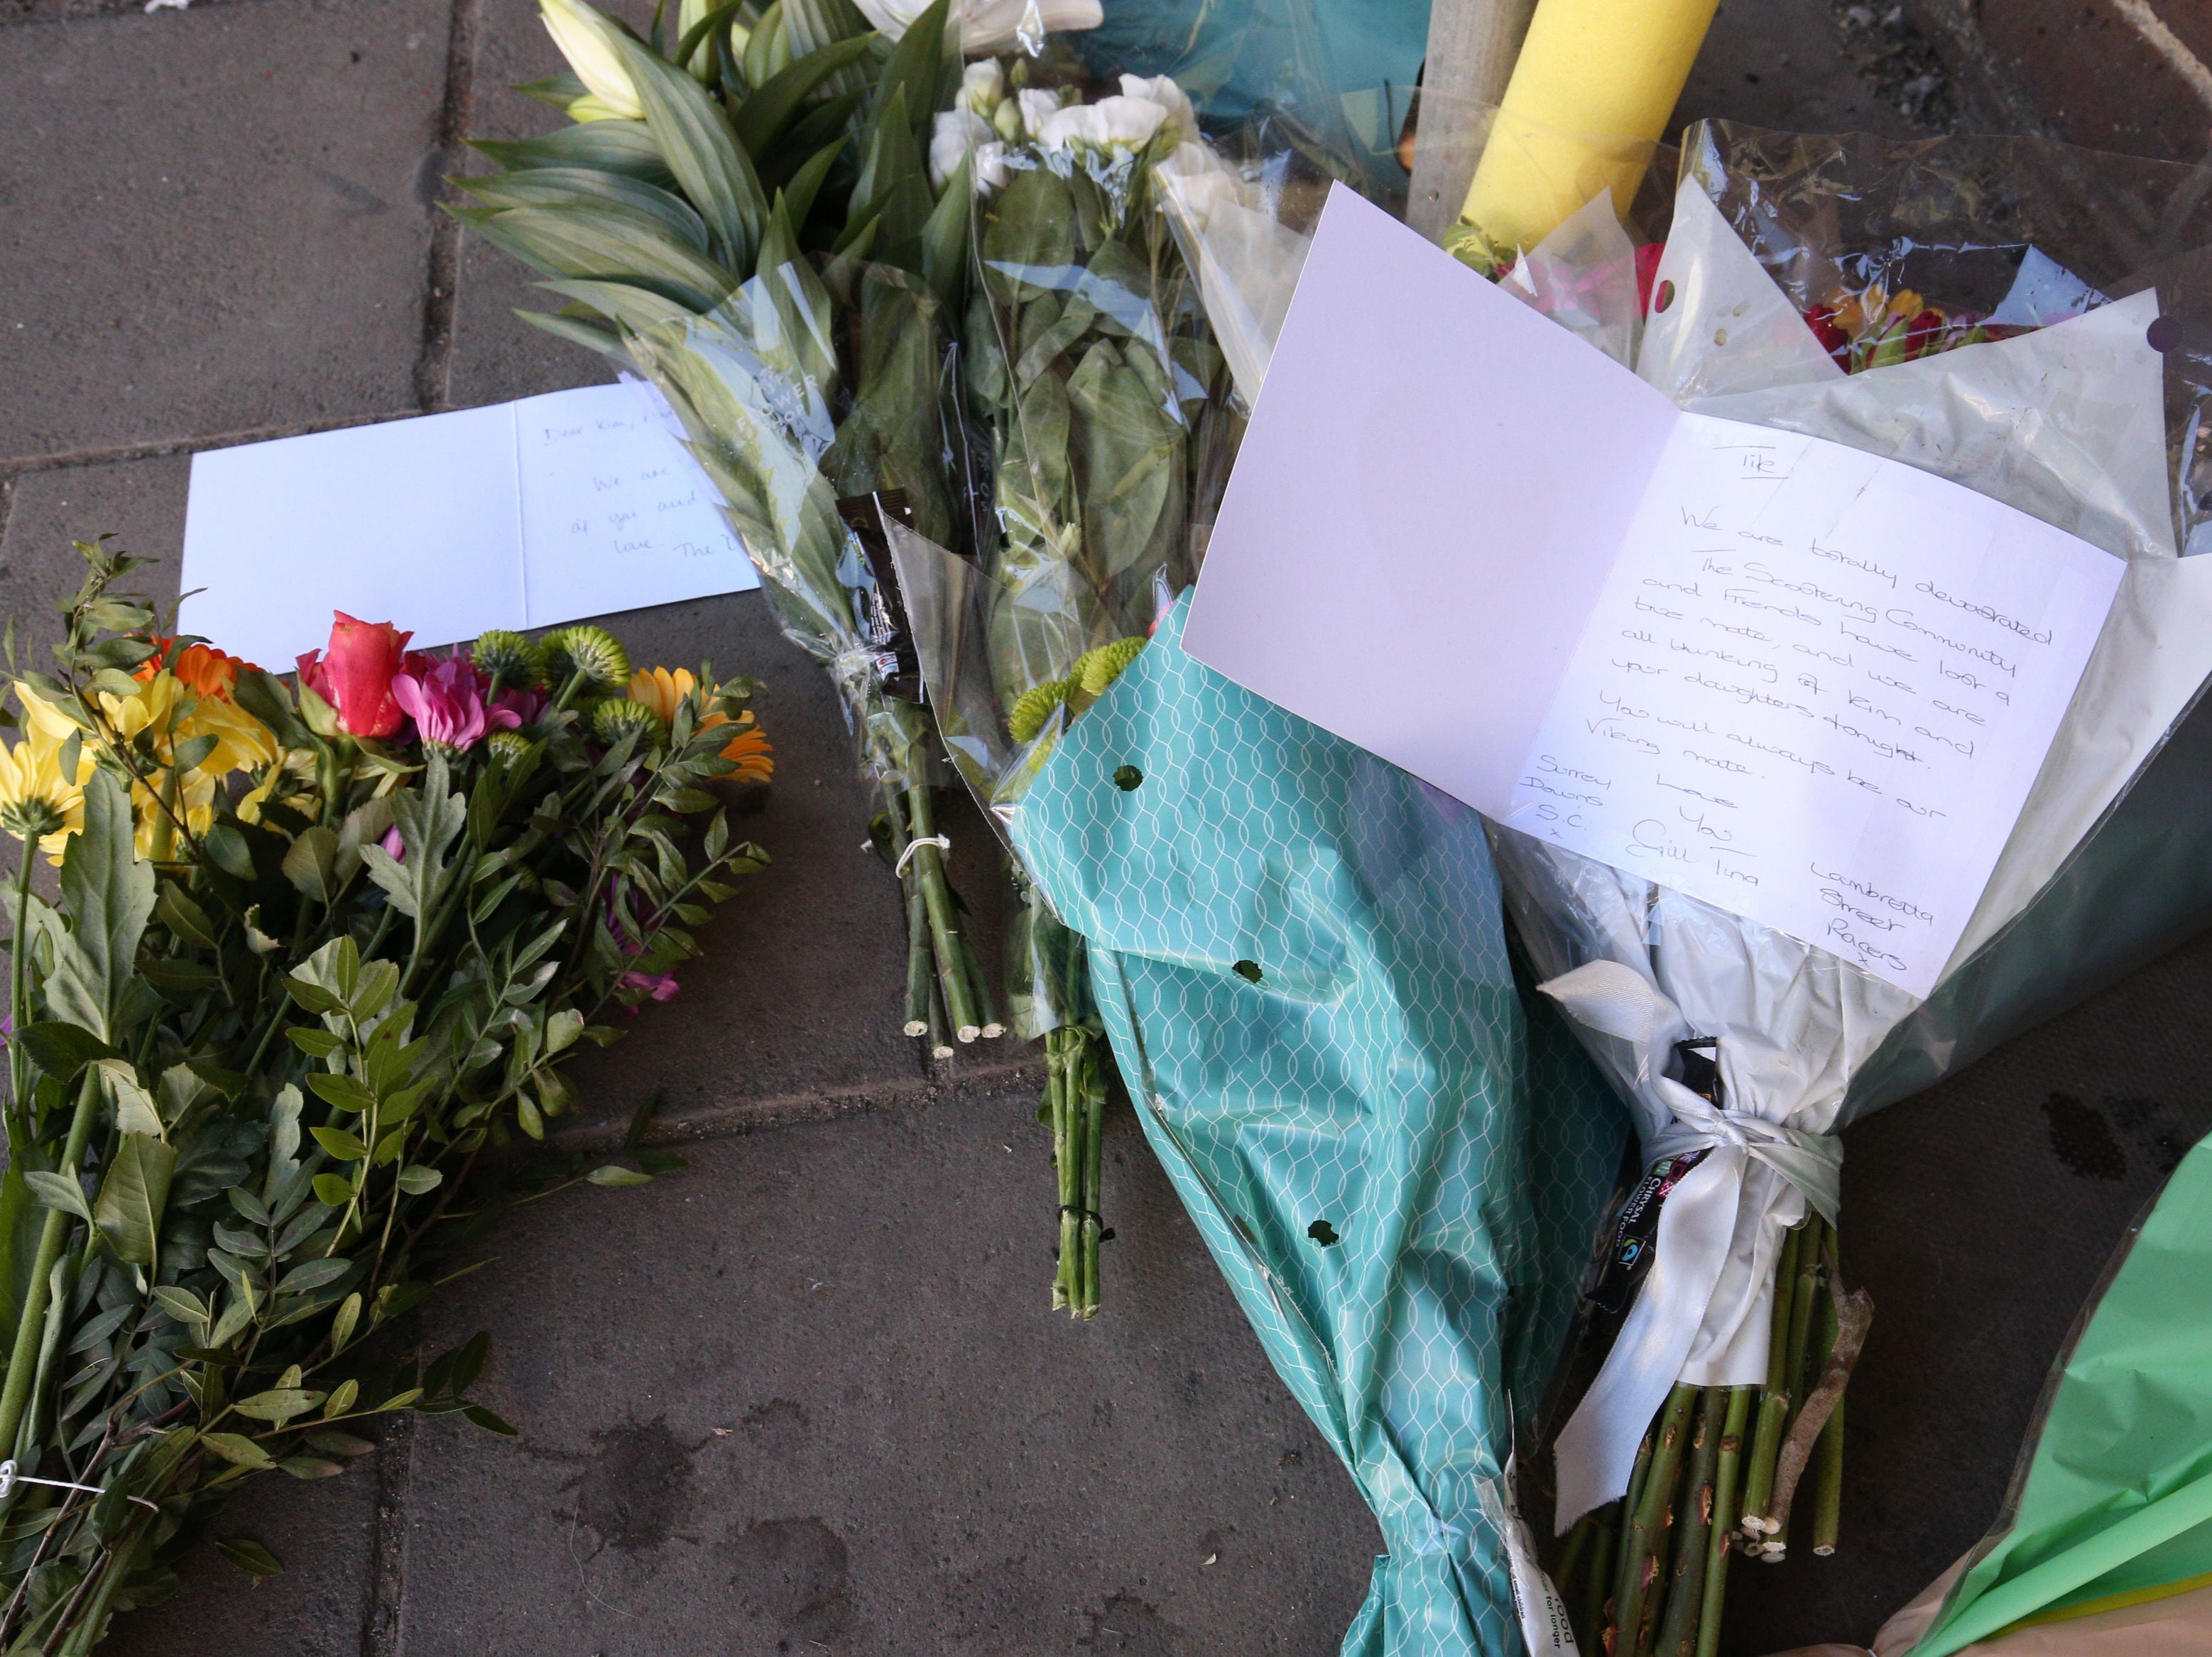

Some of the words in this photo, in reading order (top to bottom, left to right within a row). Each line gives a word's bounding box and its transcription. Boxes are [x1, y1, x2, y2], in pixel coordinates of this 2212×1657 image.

[543, 427, 584, 447] Dear
[592, 476, 619, 492] We
[641, 466, 670, 482] are
[609, 511, 638, 532] you
[657, 489, 697, 512] and
[672, 541, 714, 558] The
[1681, 506, 1723, 531] We
[1738, 531, 1784, 546] are
[1809, 538, 1897, 589] totally
[1691, 548, 1737, 575] The
[1633, 595, 1684, 620] true
[1792, 644, 1855, 668] and
[1868, 670, 1917, 695] we
[1933, 700, 1987, 727] are
[1642, 578, 1703, 597] and
[1724, 588, 1822, 626] Friends
[1841, 621, 1920, 662] have
[1995, 690, 2010, 706] a
[1621, 630, 1658, 644] all
[1670, 639, 1778, 683] thinking
[1914, 726, 1974, 759] and
[1684, 671, 1815, 718] daughters
[1586, 717, 1660, 755] Viking
[1536, 754, 1612, 790] Surrey
[1657, 716, 1717, 734] will
[1726, 733, 1836, 776] always
[1847, 768, 1883, 794] be
[1896, 798, 1947, 817] our
[1519, 776, 1604, 807] Downs
[1811, 862, 1934, 927] Lambretta
[1827, 918, 1907, 971] Racers
[1625, 1176, 1652, 1215] FLOWER
[1628, 1178, 1662, 1224] CHRYSAL
[1616, 1215, 1629, 1247] FOOD
[1549, 1614, 1561, 1649] longer
